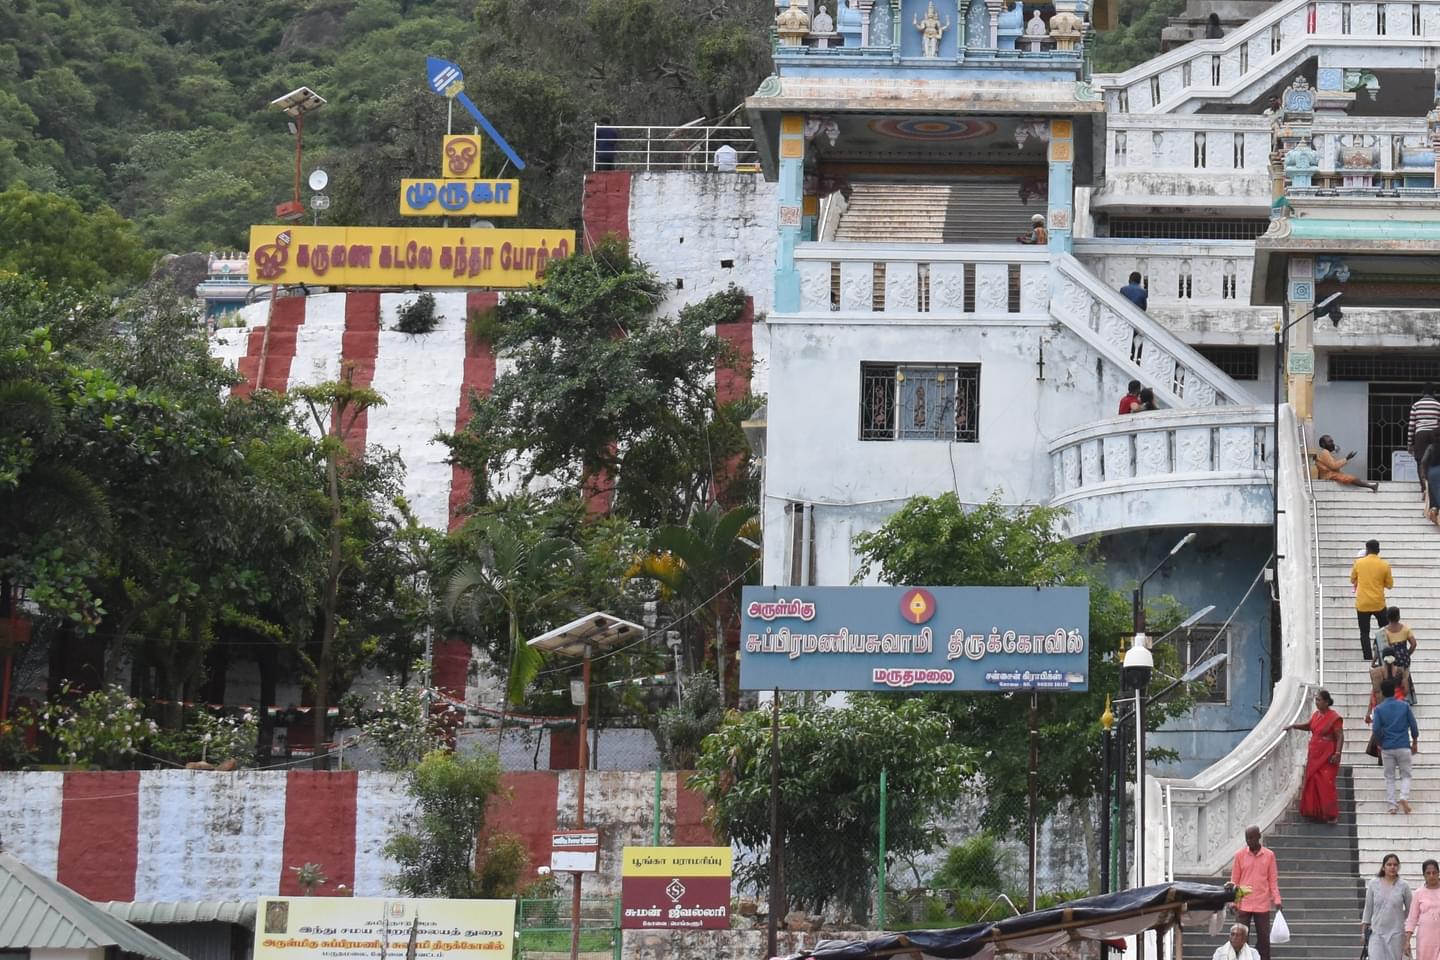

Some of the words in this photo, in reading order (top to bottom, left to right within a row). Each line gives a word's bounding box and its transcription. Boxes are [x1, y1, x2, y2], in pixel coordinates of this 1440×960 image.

[406, 182, 512, 211] முருகா
[296, 243, 372, 276] கருணை
[379, 240, 432, 270] கடலே
[440, 237, 494, 279] கந்தா
[748, 599, 815, 621] அருள்மிகு
[746, 627, 933, 660] சுப்பிரமணியசுவாமி
[947, 628, 1084, 660] திருக்கோவில்
[873, 668, 954, 687] மருதமலை
[632, 856, 666, 867] பூங்கா
[672, 855, 722, 866] பராமரிப்பு
[671, 885, 680, 896] S
[625, 905, 662, 917] சுமன்
